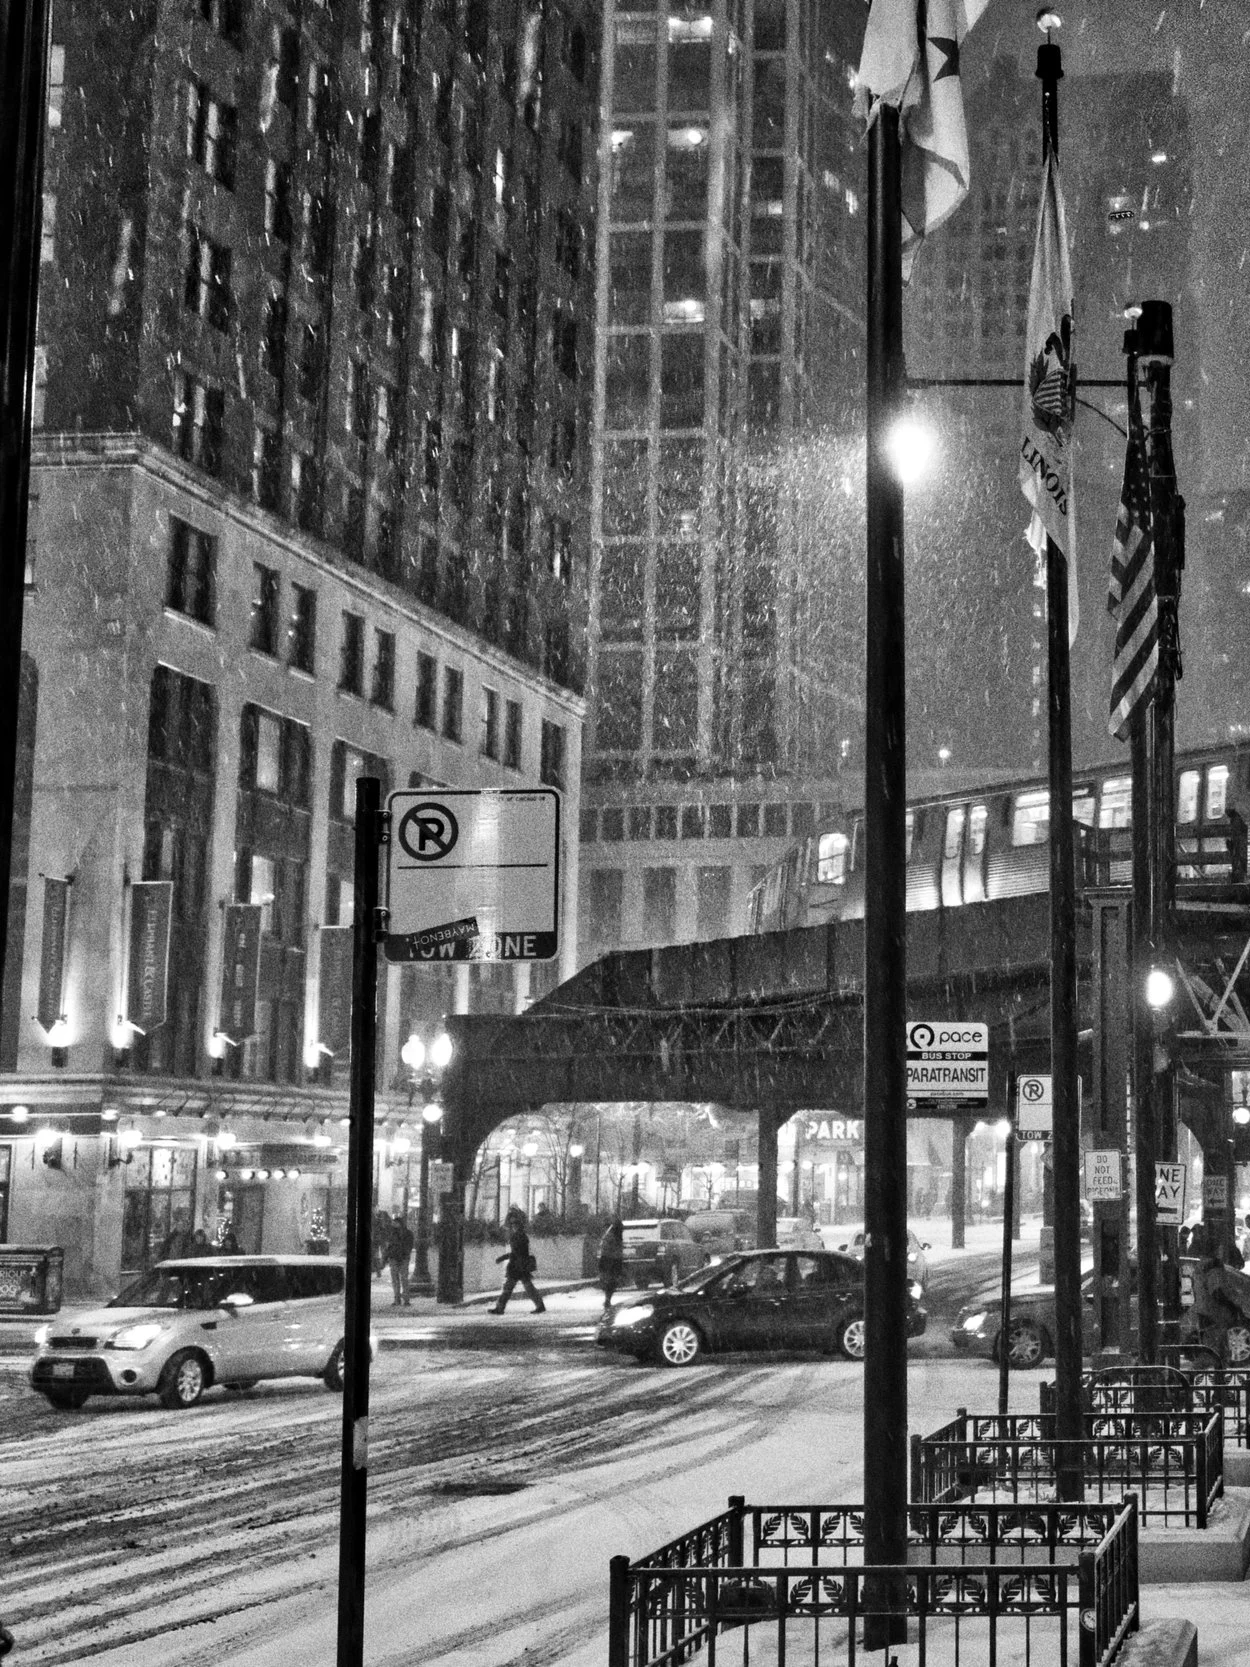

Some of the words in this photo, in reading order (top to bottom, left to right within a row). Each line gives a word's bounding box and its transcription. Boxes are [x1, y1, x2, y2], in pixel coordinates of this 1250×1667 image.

[939, 1031, 983, 1045] pace
[921, 1052, 943, 1060] BUS
[944, 1052, 972, 1060] STOP
[906, 1067, 986, 1083] PARATRANSIT
[805, 1120, 860, 1140] PARK
[1022, 1131, 1042, 1140] TOW
[1096, 1155, 1108, 1163] DO
[1094, 1165, 1110, 1174] NOT
[1092, 1176, 1113, 1185] FEED
[1159, 1168, 1181, 1183] NE
[1157, 1185, 1181, 1199] AY
